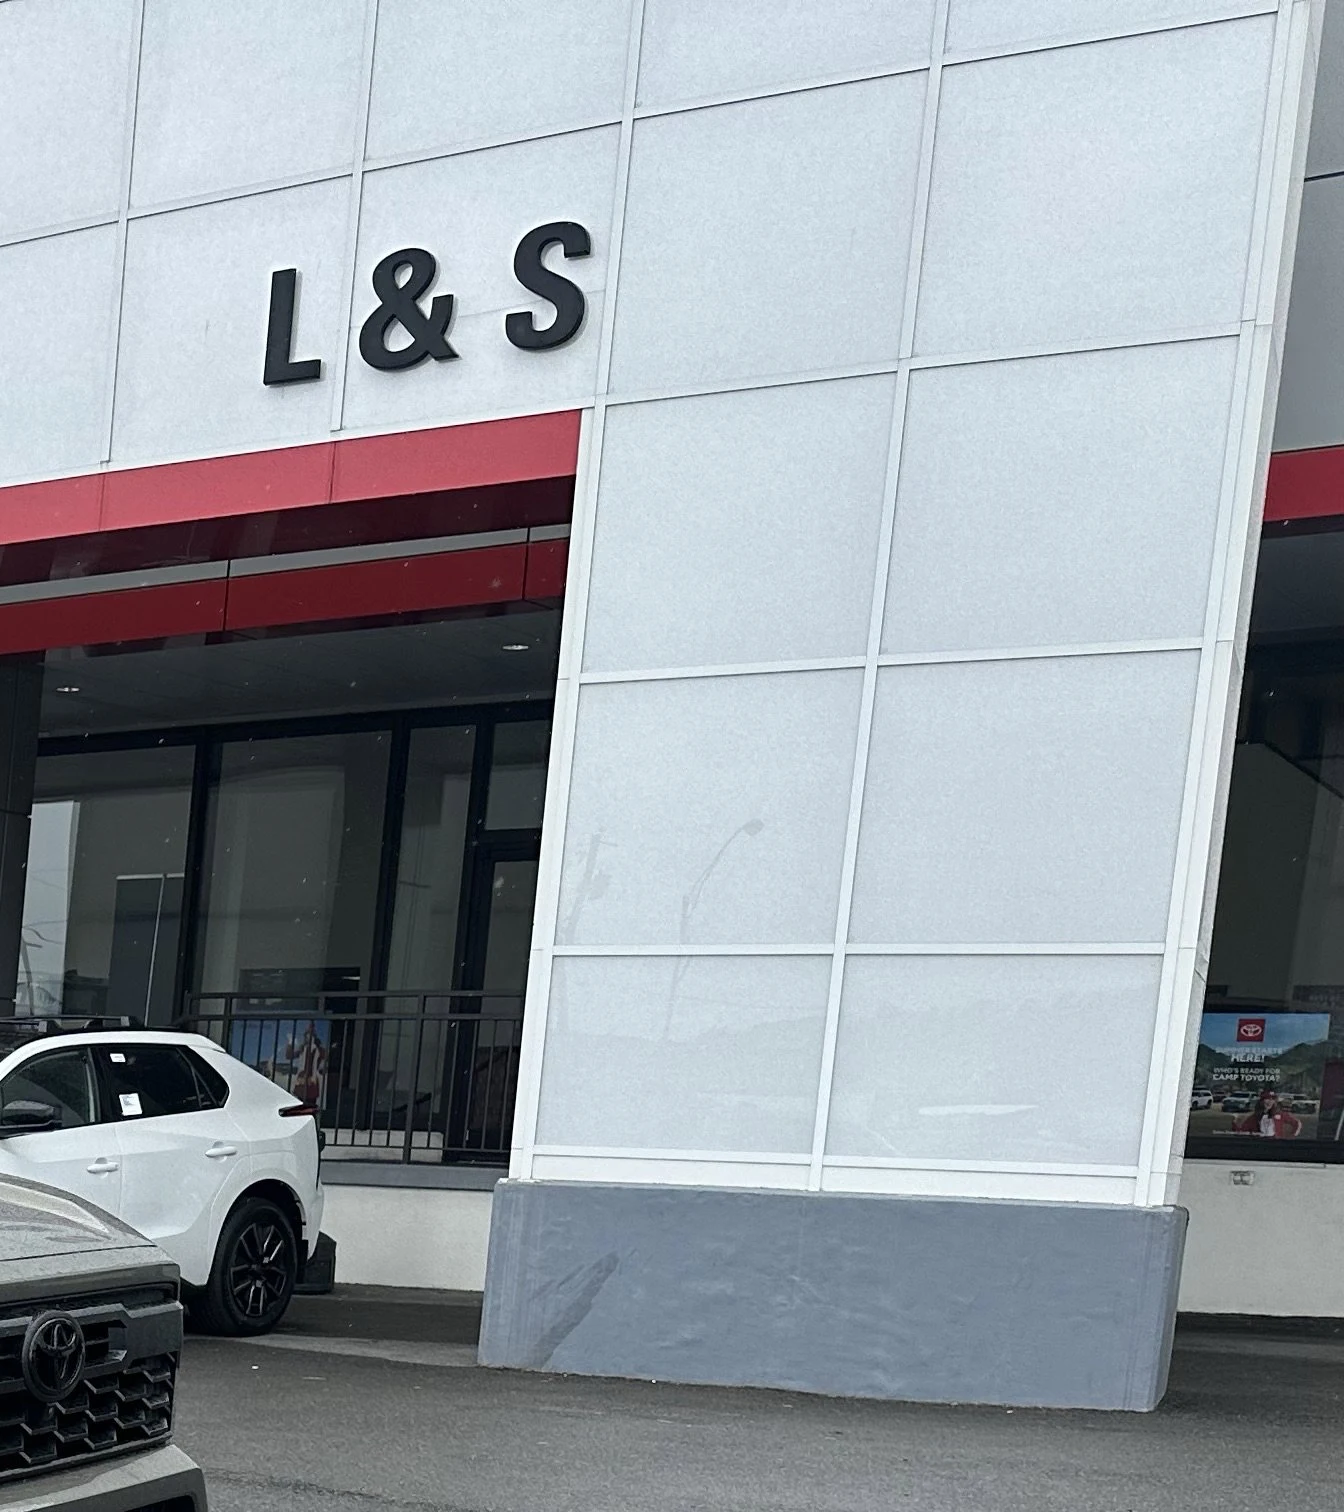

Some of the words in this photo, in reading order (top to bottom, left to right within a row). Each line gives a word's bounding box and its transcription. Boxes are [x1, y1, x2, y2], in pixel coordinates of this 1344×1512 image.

[264, 268, 322, 386] L
[359, 247, 460, 371] &
[505, 221, 592, 351] S
[1212, 1073, 1239, 1081] CAMP
